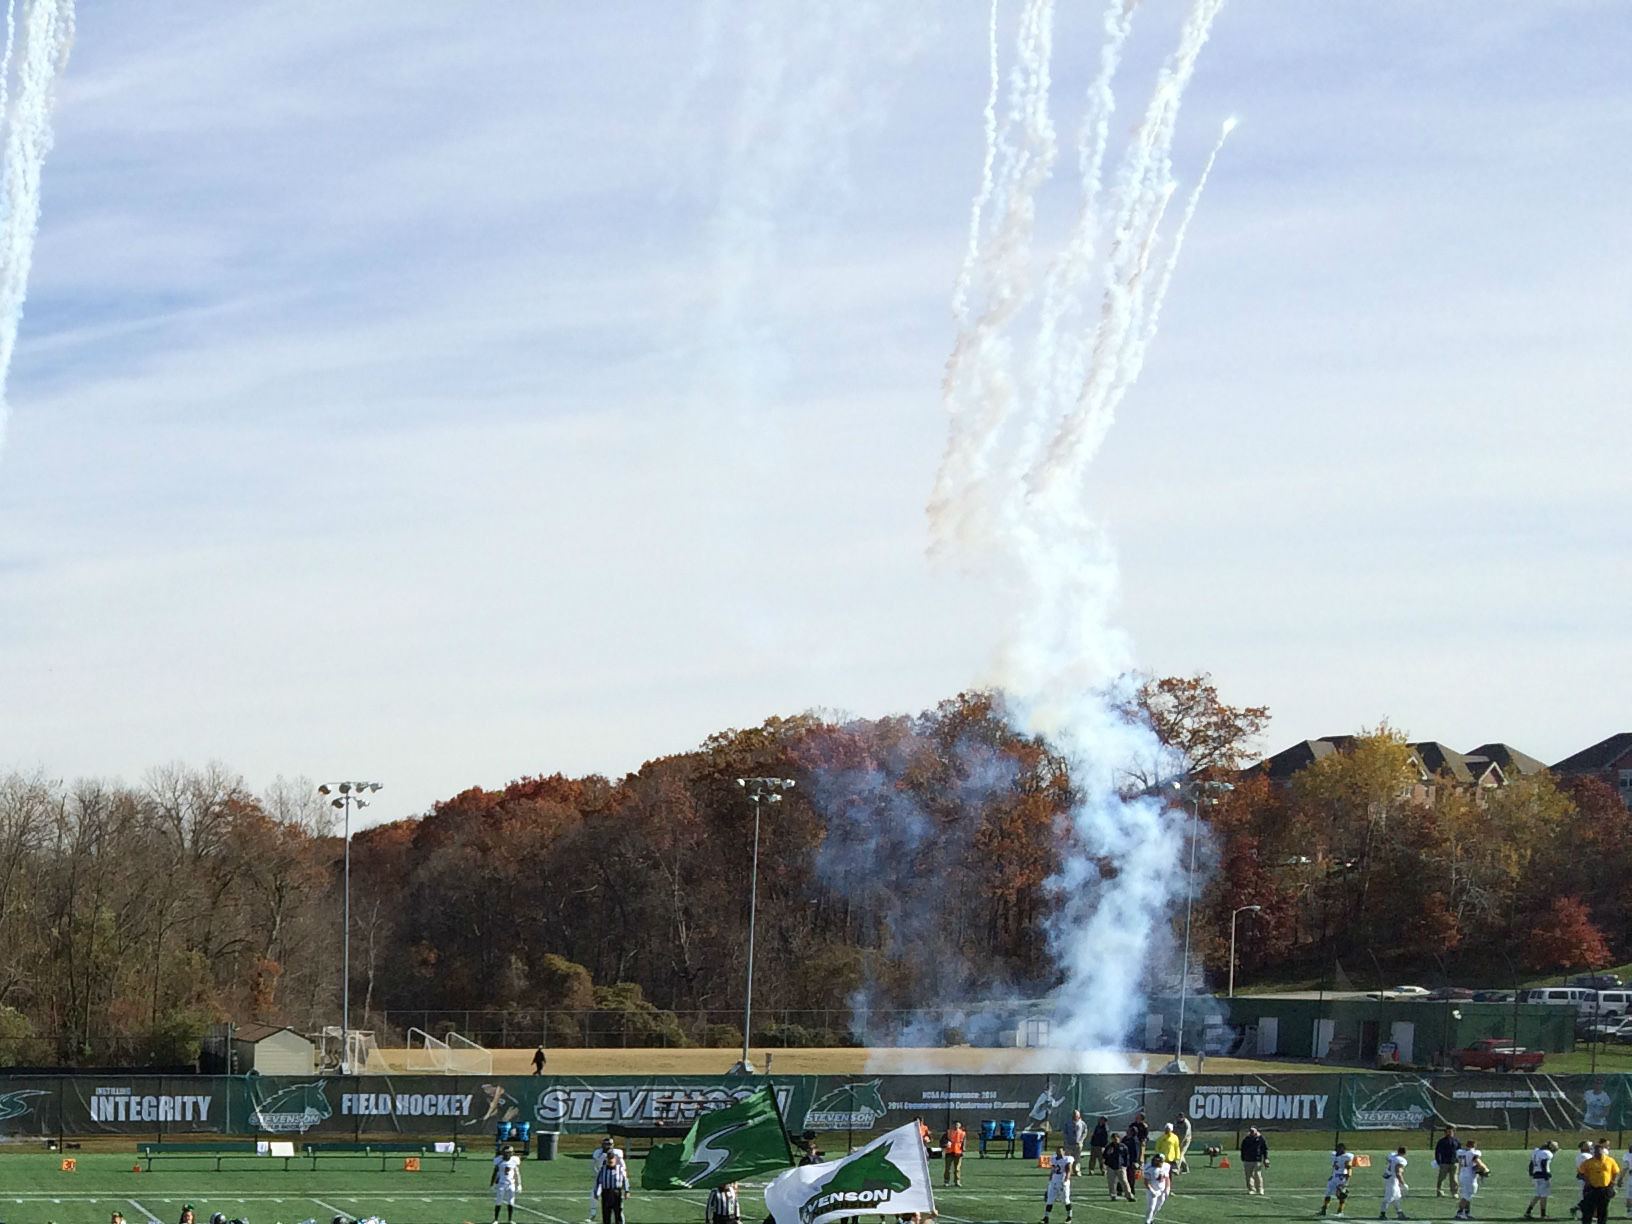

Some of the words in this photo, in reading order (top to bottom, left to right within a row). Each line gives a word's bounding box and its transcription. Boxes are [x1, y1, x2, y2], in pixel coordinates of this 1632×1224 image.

[90, 1095, 212, 1121] INTEGRITY
[342, 1094, 391, 1115] FIELD
[396, 1094, 472, 1116] HOCKEY
[806, 1113, 875, 1121] STEVENSON
[1189, 1094, 1329, 1119] COMMUNITY
[807, 1188, 888, 1212] VENSON
